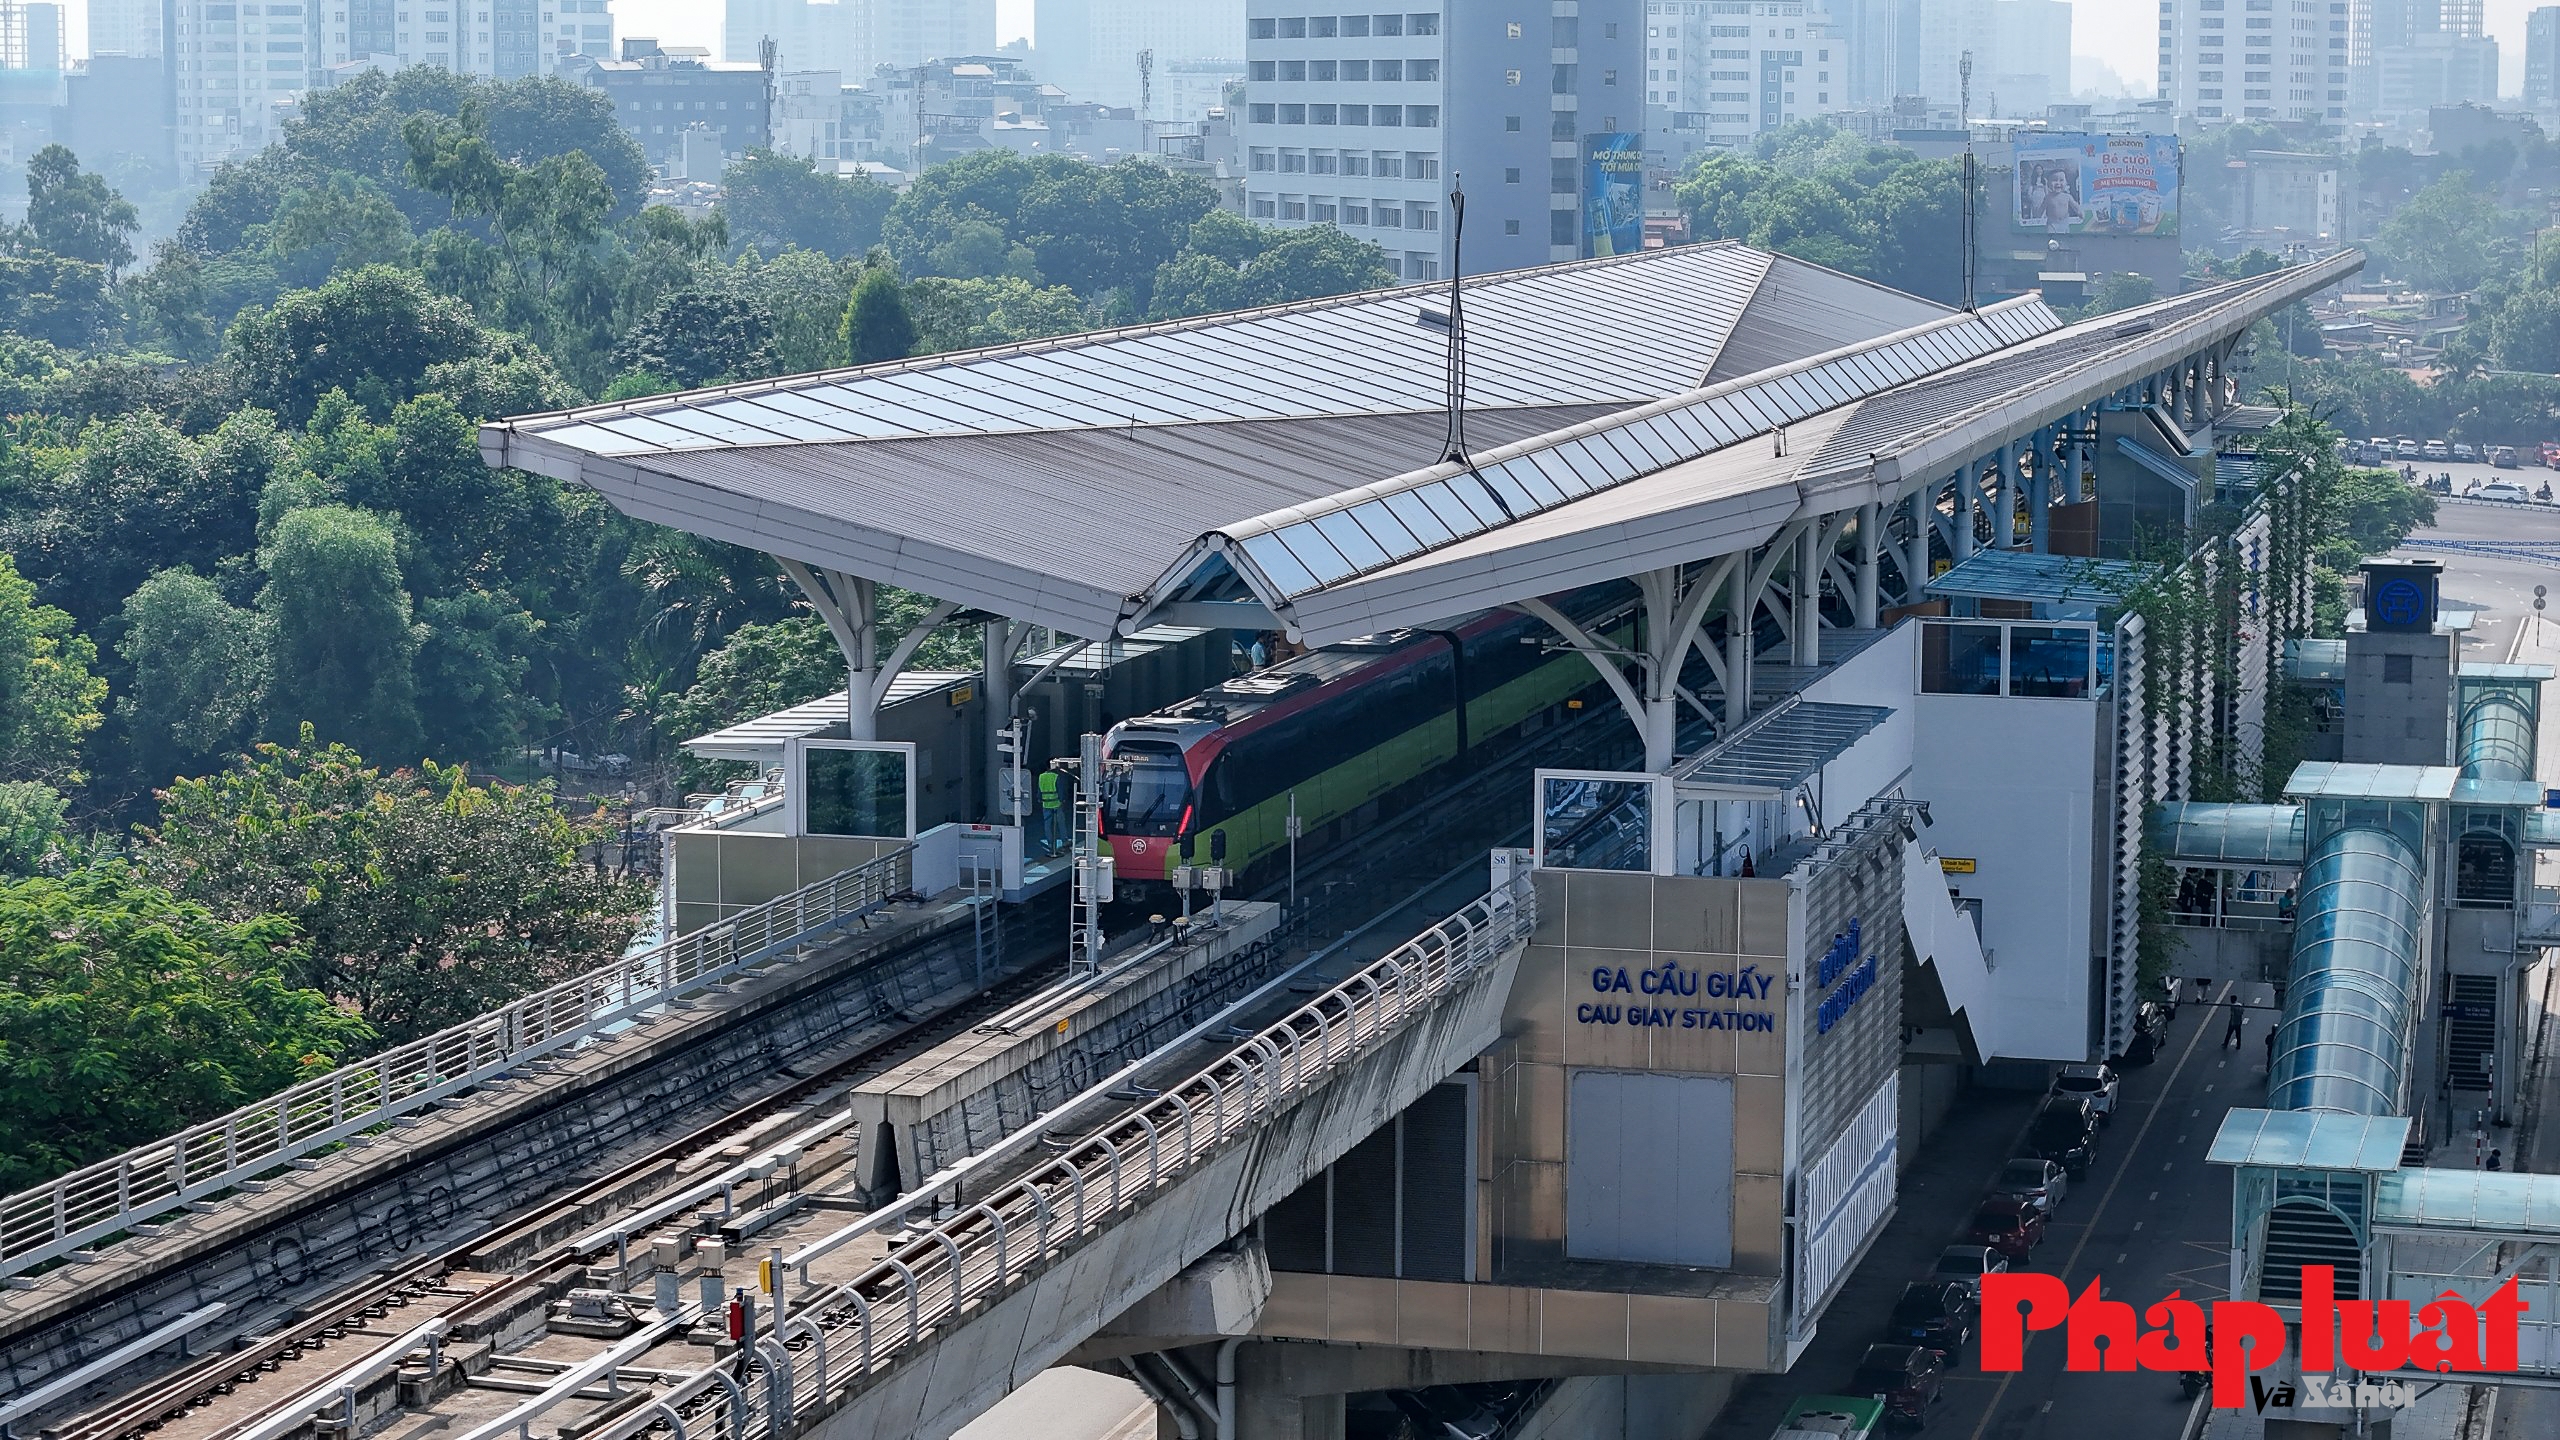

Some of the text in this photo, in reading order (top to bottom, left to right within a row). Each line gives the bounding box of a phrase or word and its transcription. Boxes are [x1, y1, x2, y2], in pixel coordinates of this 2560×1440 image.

[1494, 856, 1506, 864] S8
[1592, 966, 1633, 994] GA
[1640, 960, 1698, 997] CẦU
[1707, 963, 1774, 1001] GIẤY
[1577, 1002, 1775, 1034] CAU GIAY STATION
